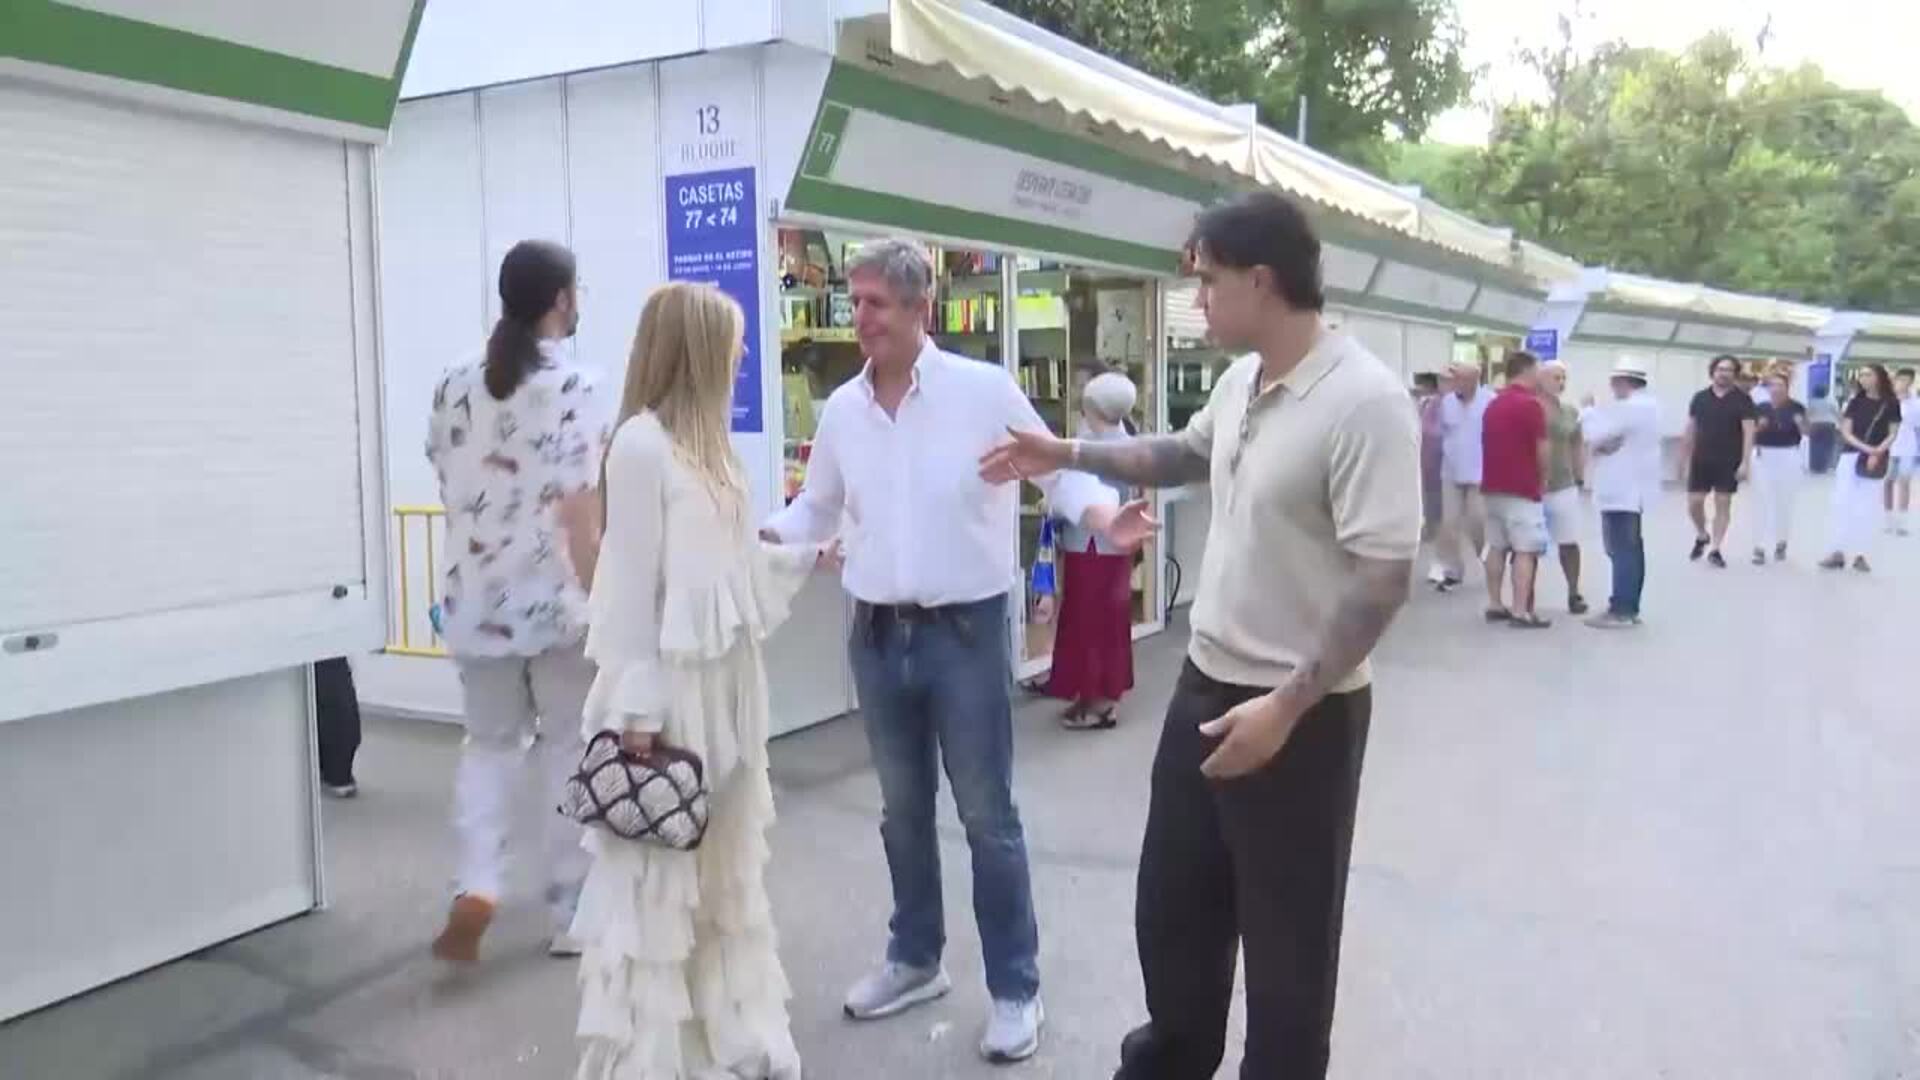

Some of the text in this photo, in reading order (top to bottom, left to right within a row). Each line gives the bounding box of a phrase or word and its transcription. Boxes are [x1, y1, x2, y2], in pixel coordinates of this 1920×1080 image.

[696, 105, 720, 134] 13
[679, 181, 744, 206] CASETAS
[686, 209, 703, 229] 77
[720, 206, 737, 226] 74
